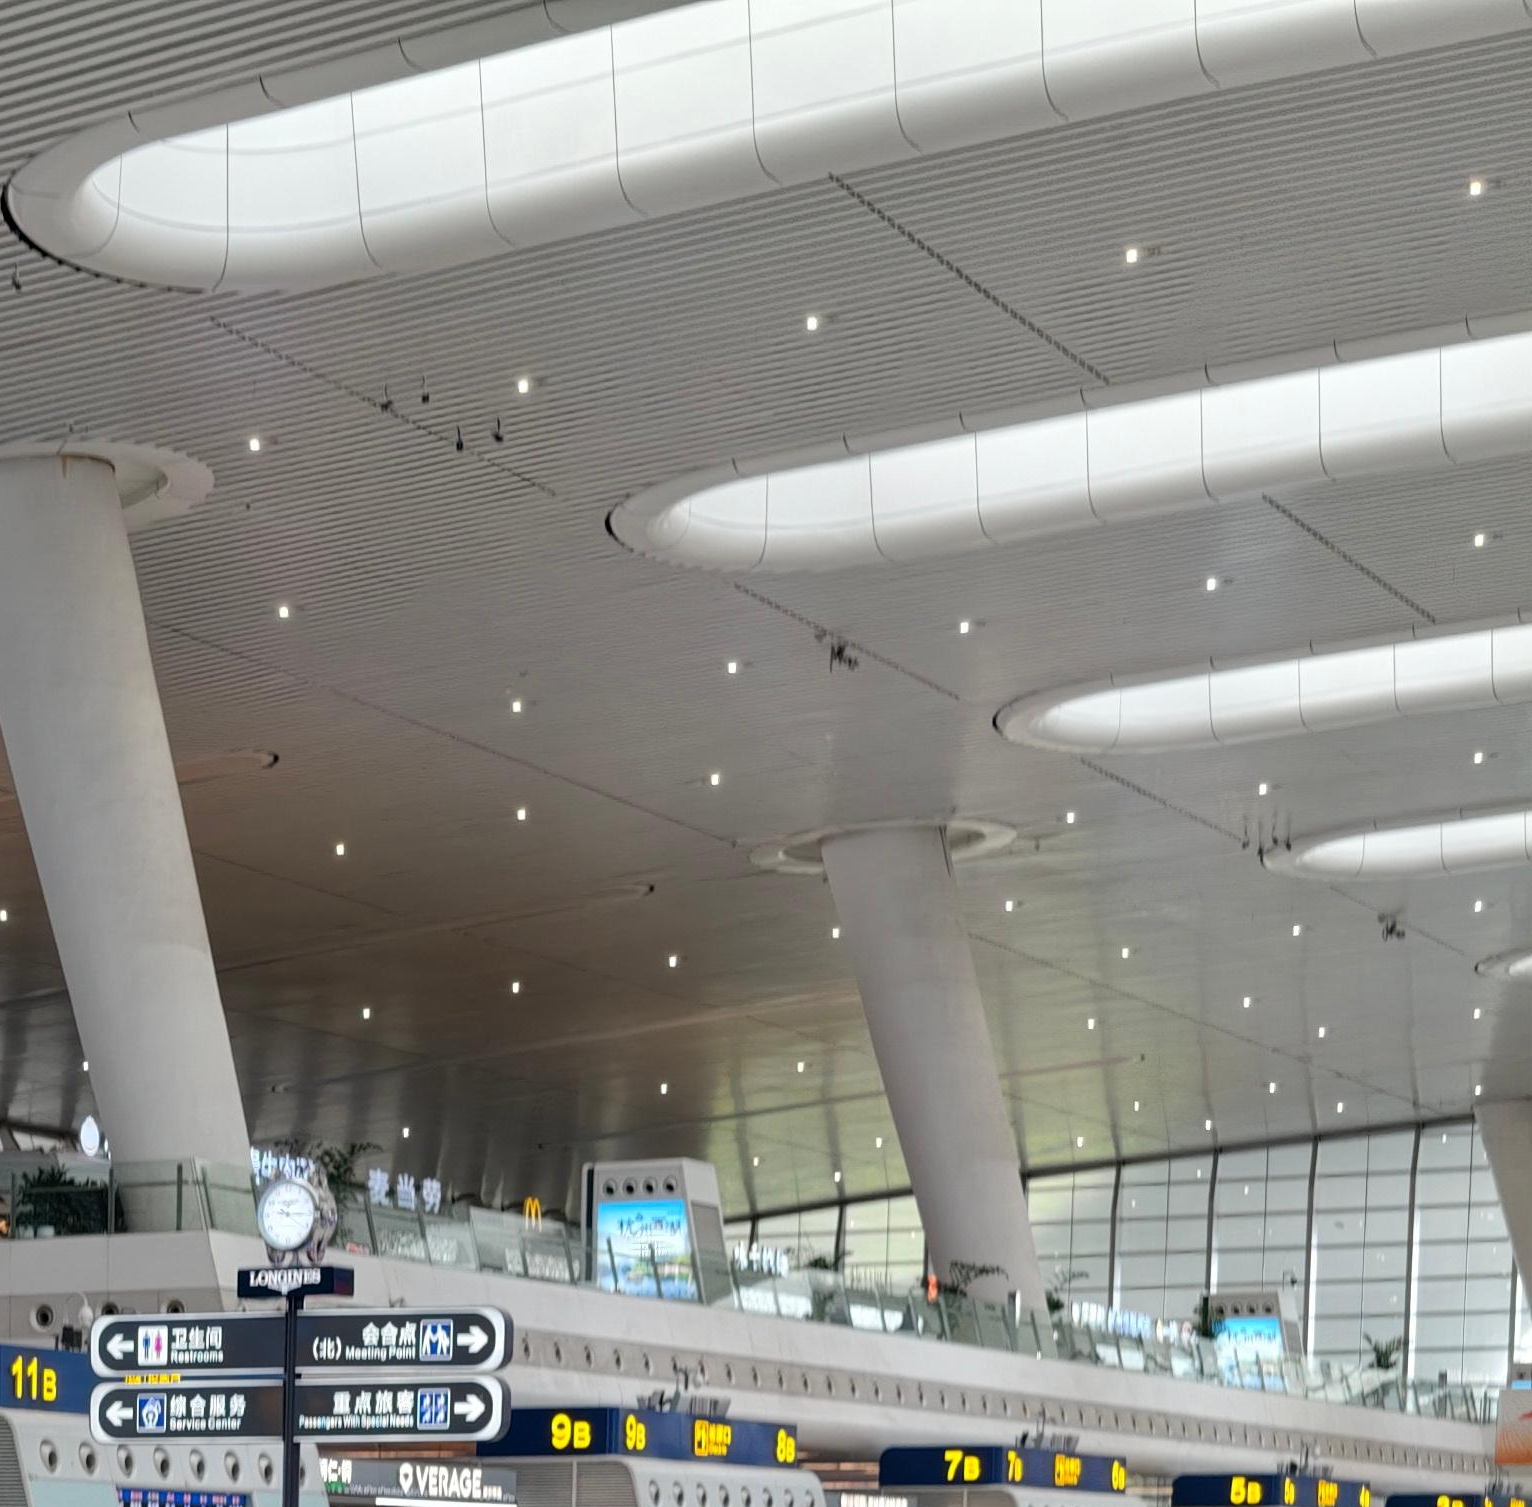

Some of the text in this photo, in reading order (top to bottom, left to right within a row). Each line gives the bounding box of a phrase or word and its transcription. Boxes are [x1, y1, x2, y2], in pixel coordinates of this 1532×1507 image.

[249, 1268, 322, 1288] LONGINES
[171, 1326, 223, 1350] 卫生间
[362, 1322, 417, 1347] 会合点
[171, 1350, 224, 1363] Restrooms
[345, 1346, 417, 1361] Meeting Point
[11, 1354, 58, 1402] 11B
[170, 1394, 246, 1418] 综合服务
[333, 1391, 414, 1415] 重点旅客
[170, 1417, 242, 1431] Service Center
[551, 1414, 591, 1450] 9B
[626, 1414, 646, 1450] 9B
[776, 1428, 795, 1463] 8B
[944, 1449, 980, 1481] 7B
[416, 1464, 483, 1500] VERAGE
[1230, 1476, 1262, 1505] 5B
